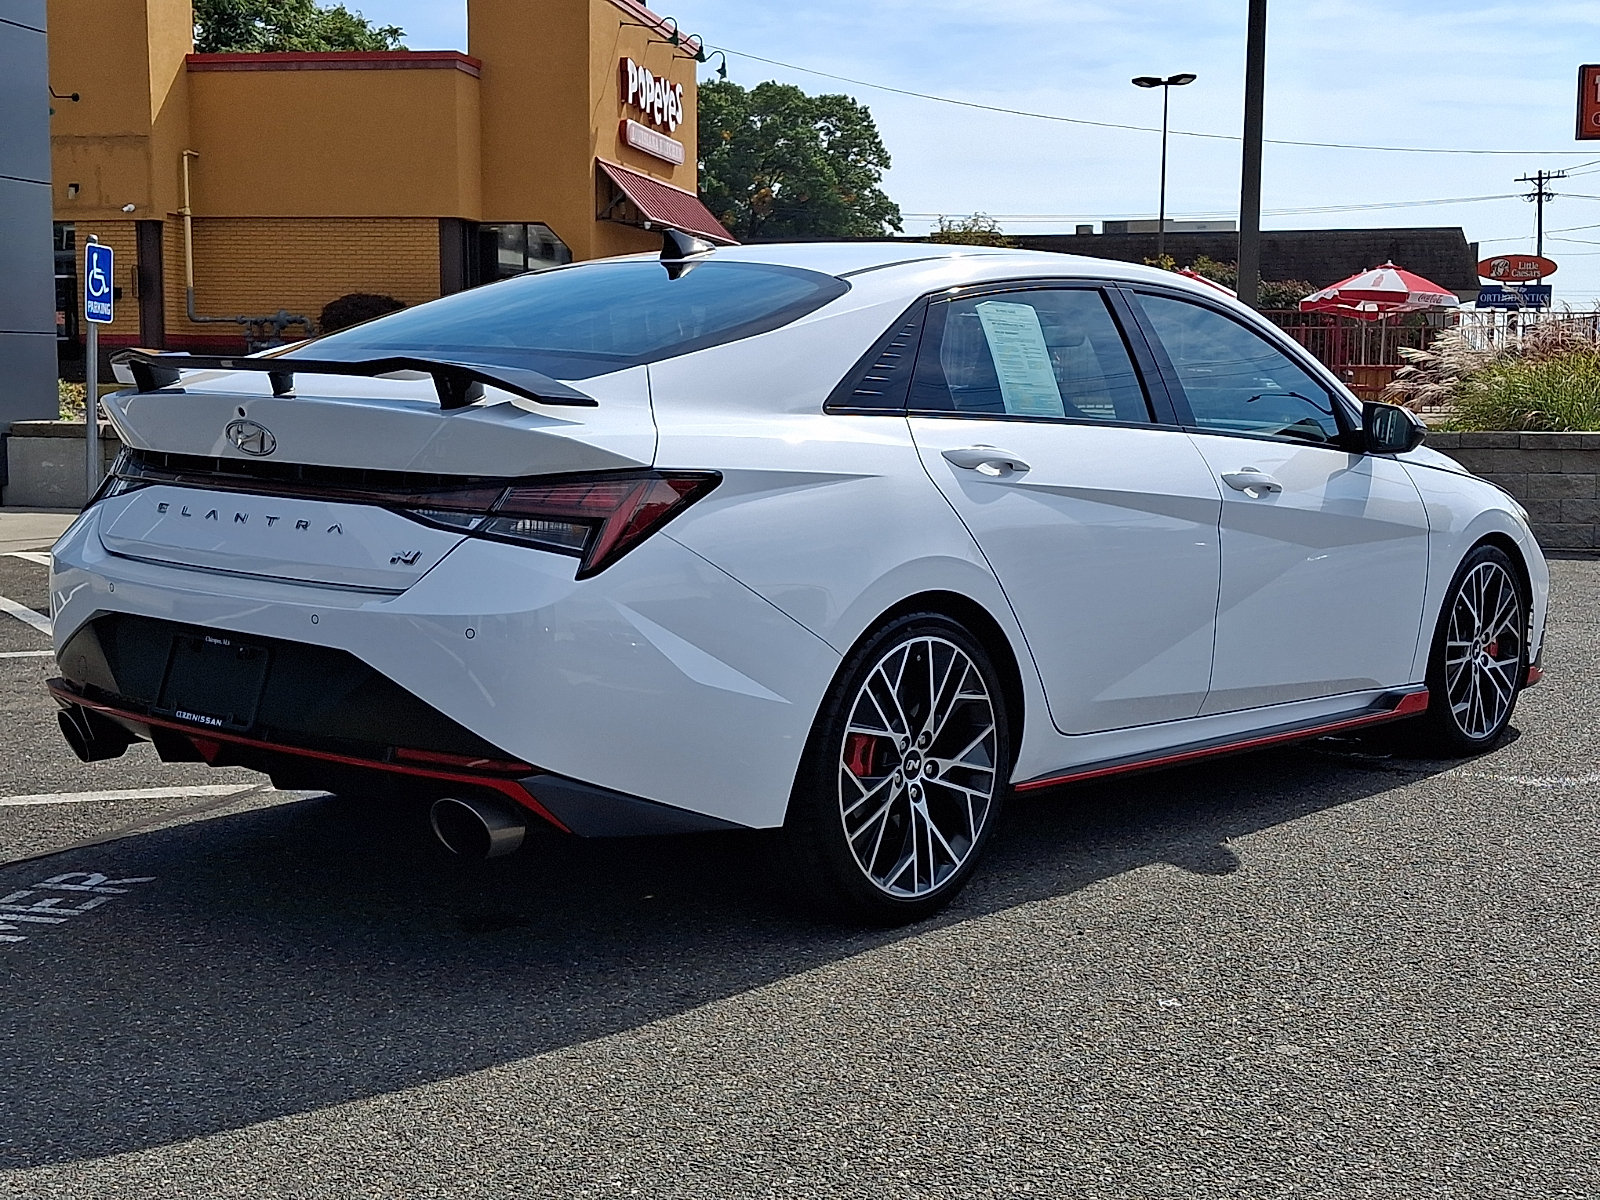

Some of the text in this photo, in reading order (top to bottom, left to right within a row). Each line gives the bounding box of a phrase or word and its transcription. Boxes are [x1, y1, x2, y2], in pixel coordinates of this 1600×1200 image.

[1511, 268, 1541, 277] Caesars
[1518, 261, 1539, 270] Little
[87, 300, 111, 315] PARKING
[157, 502, 343, 535] ELANTRA
[192, 713, 222, 727] NISSAN
